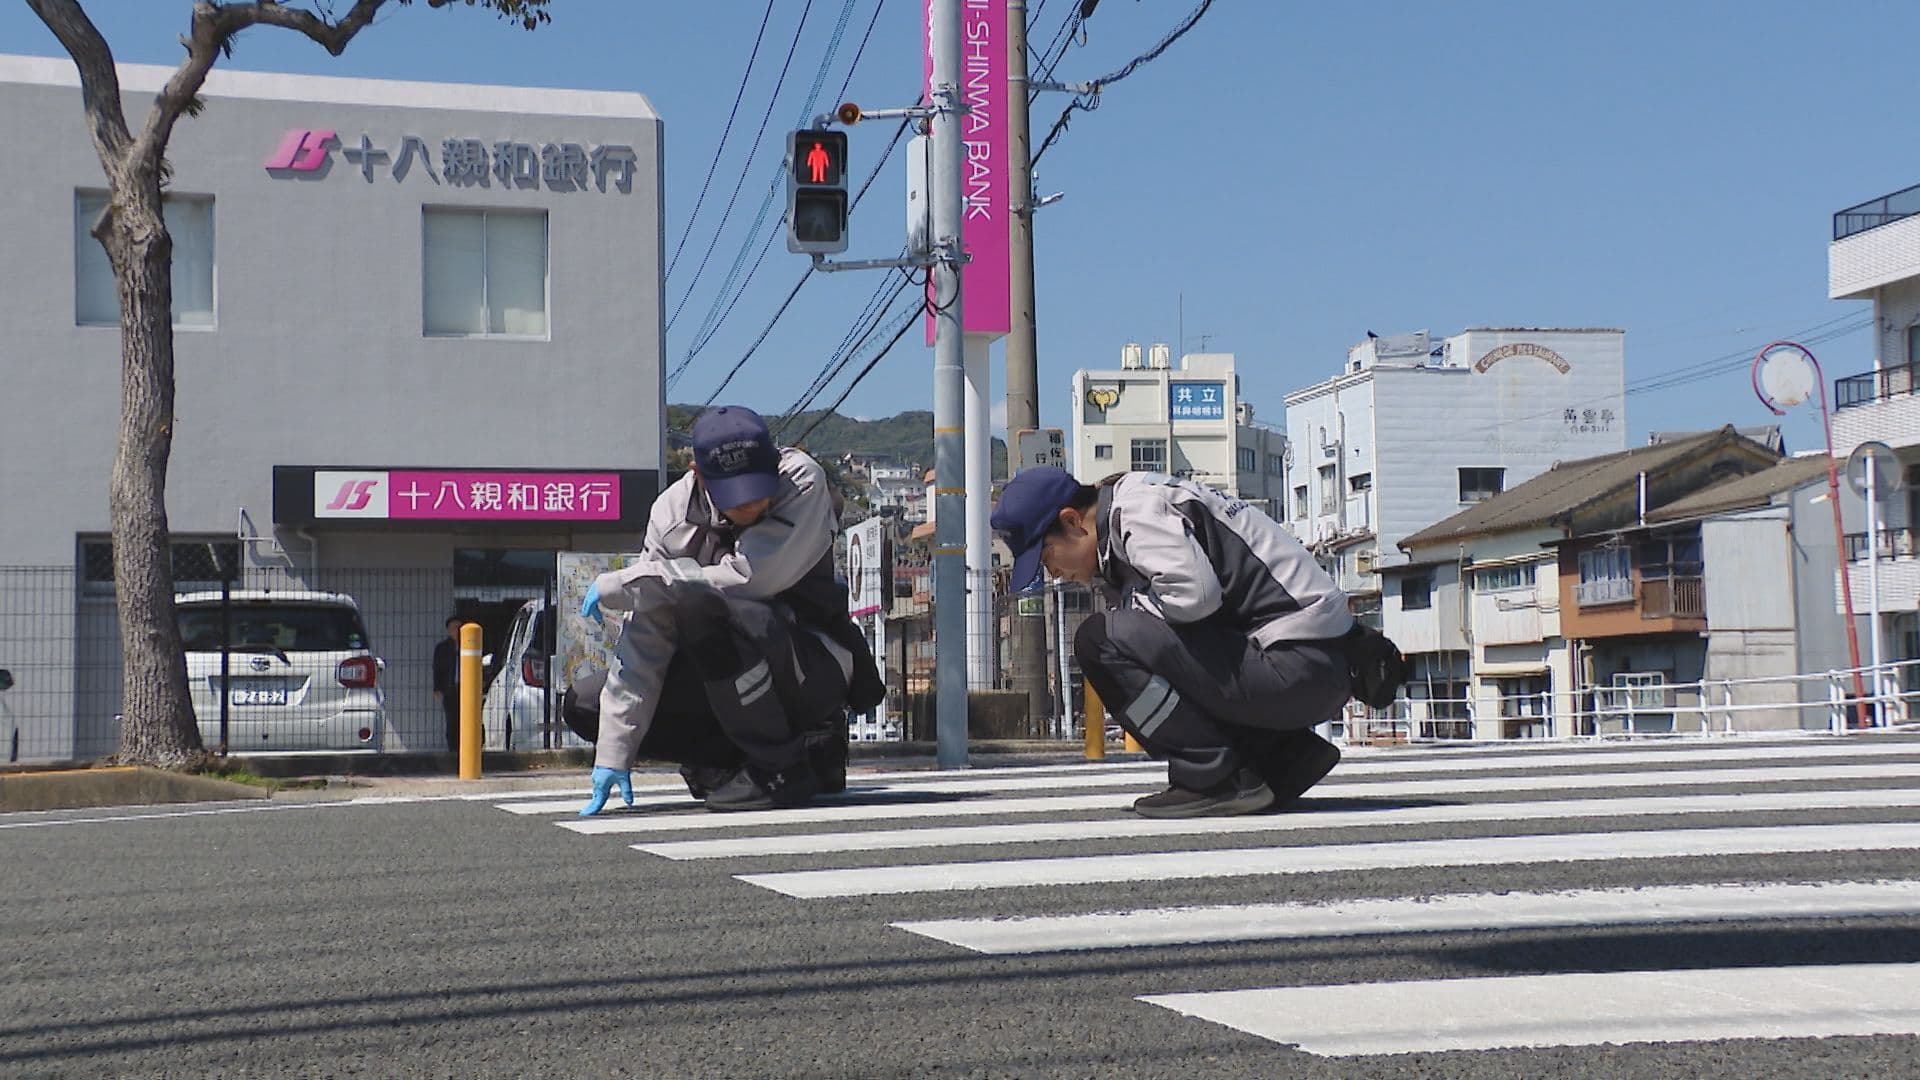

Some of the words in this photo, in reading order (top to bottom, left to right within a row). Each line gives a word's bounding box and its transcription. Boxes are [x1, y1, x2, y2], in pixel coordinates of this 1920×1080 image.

[966, 0, 990, 133] I-SHINWA
[342, 134, 637, 193] 十八親和銀行
[966, 141, 991, 220] BANK
[1177, 387, 1217, 402] 共立
[397, 481, 611, 512] 十八親和銀行
